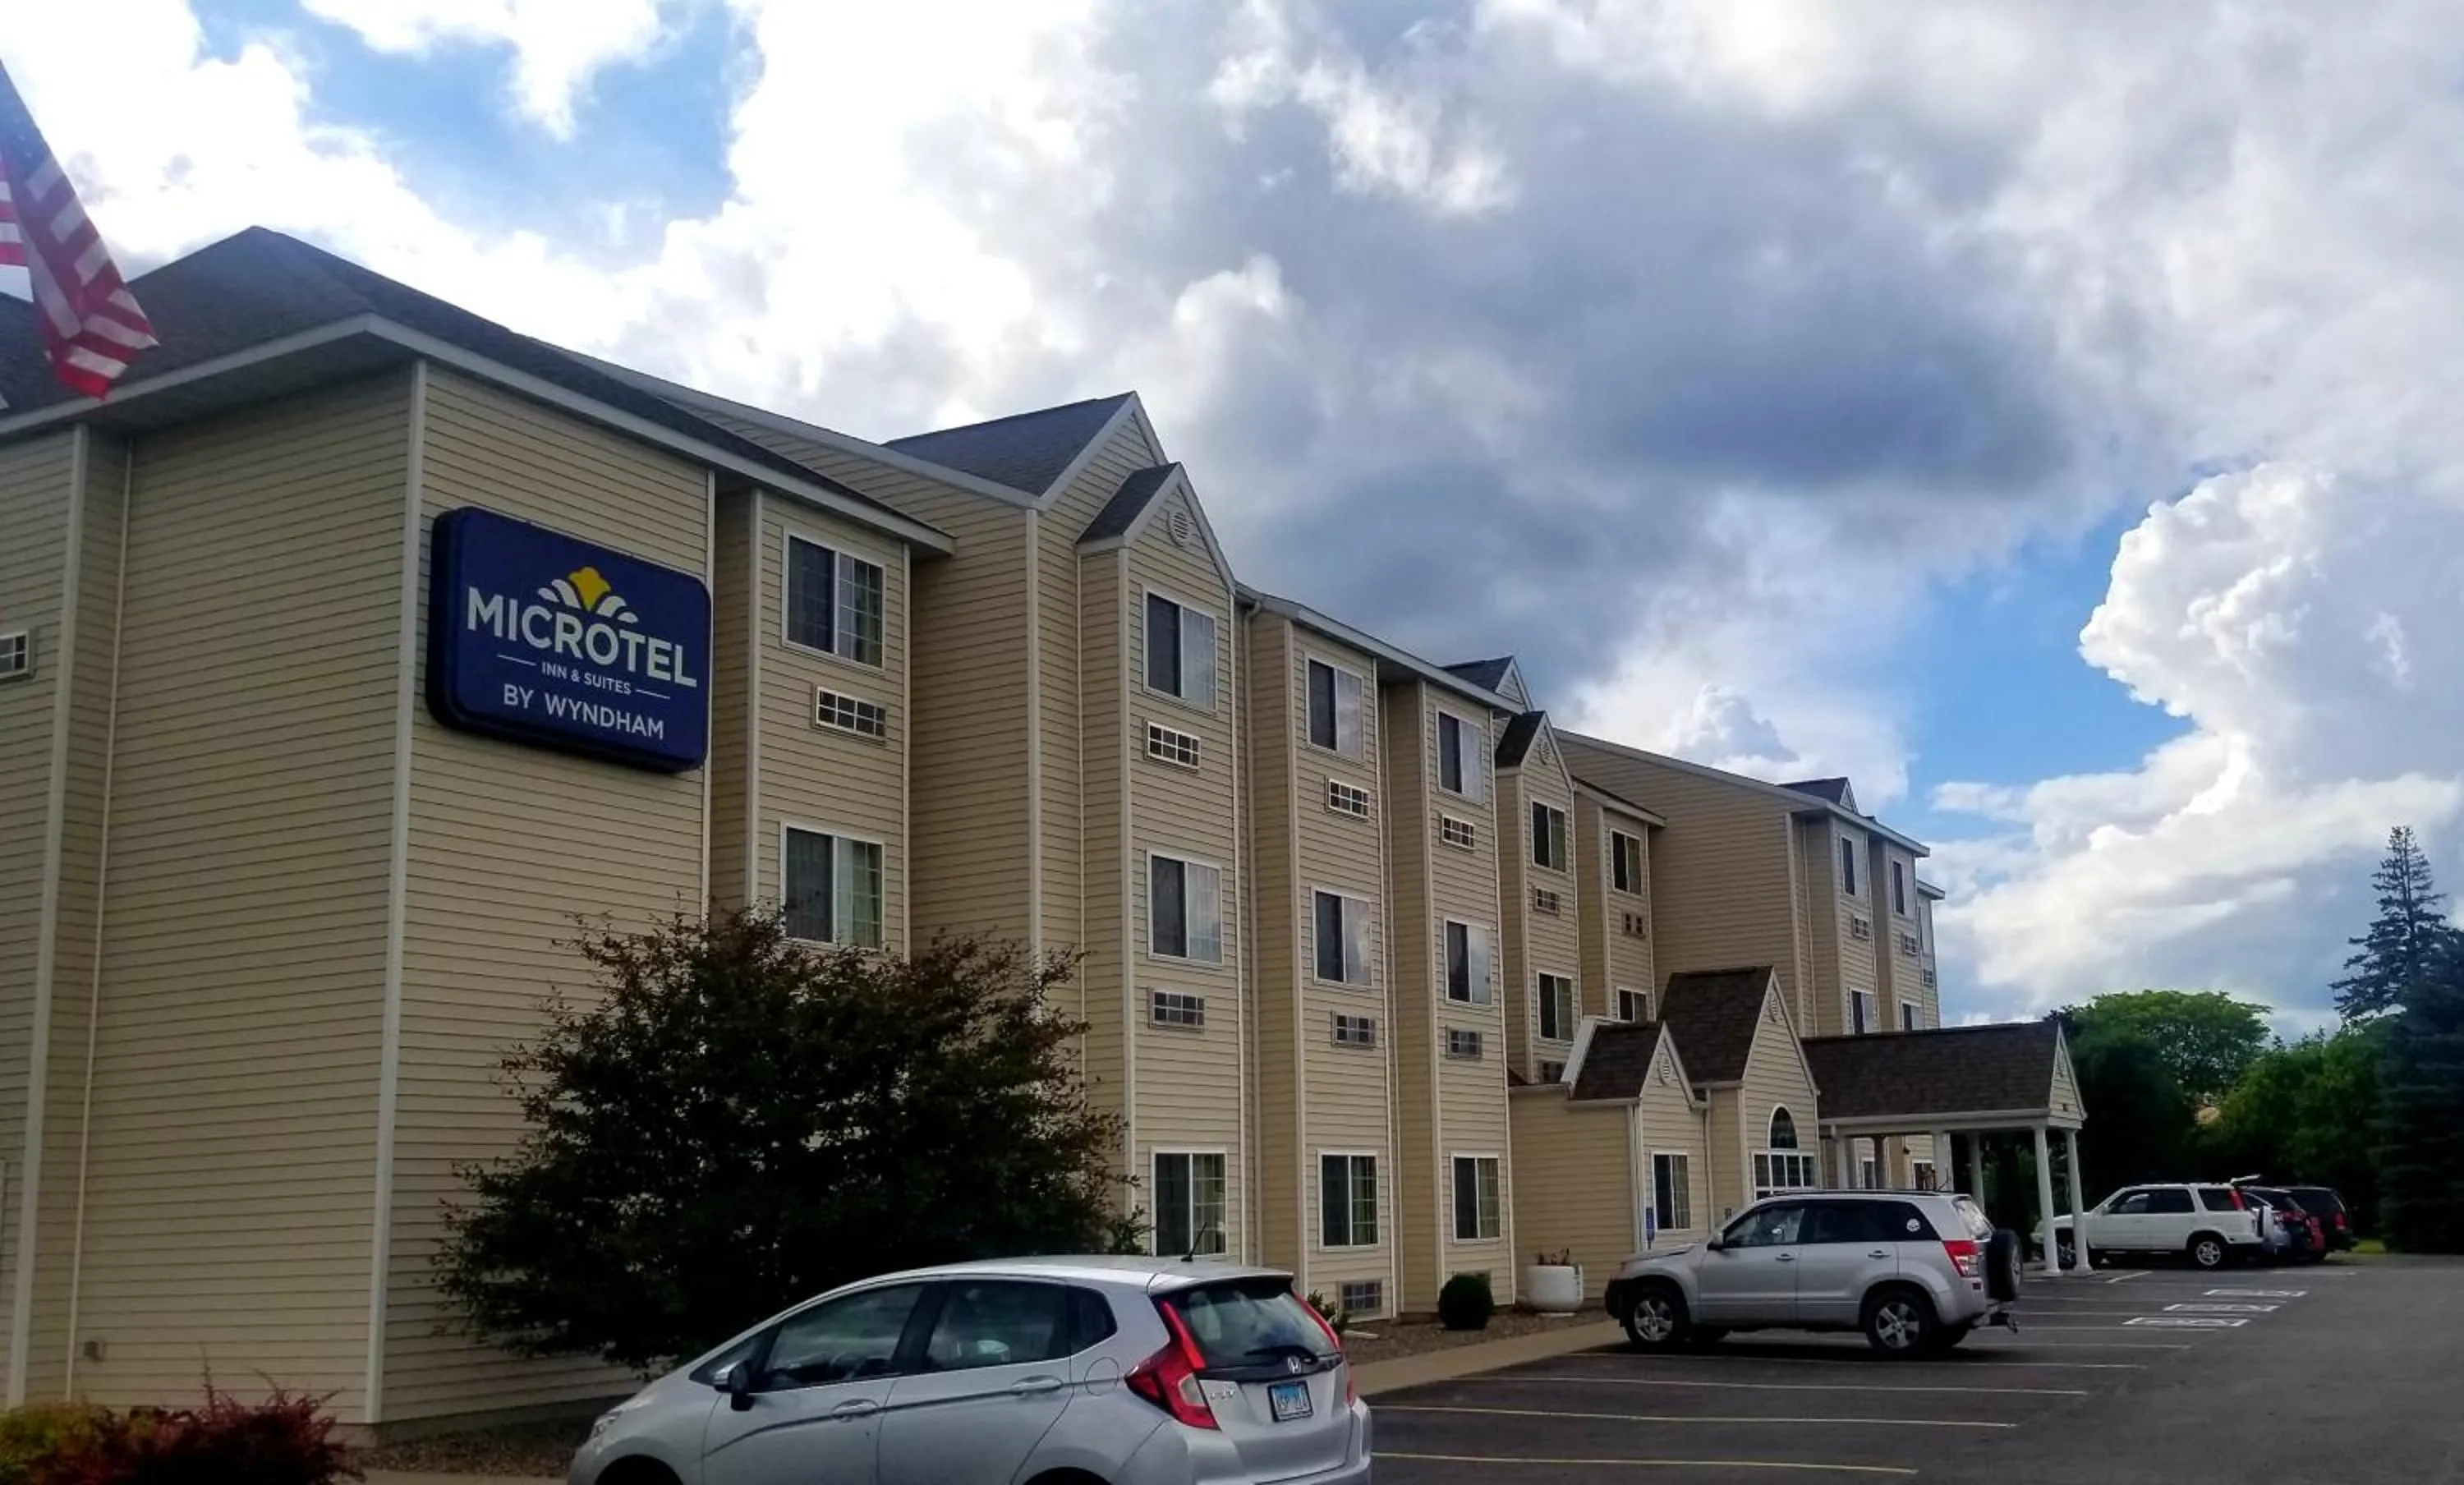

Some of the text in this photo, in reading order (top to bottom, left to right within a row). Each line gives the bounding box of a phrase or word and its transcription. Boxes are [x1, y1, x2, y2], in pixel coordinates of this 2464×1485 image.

[467, 586, 696, 687] MICROTEL
[542, 661, 632, 694] INN & SUITES
[503, 683, 664, 739] BY WYNDHAM
